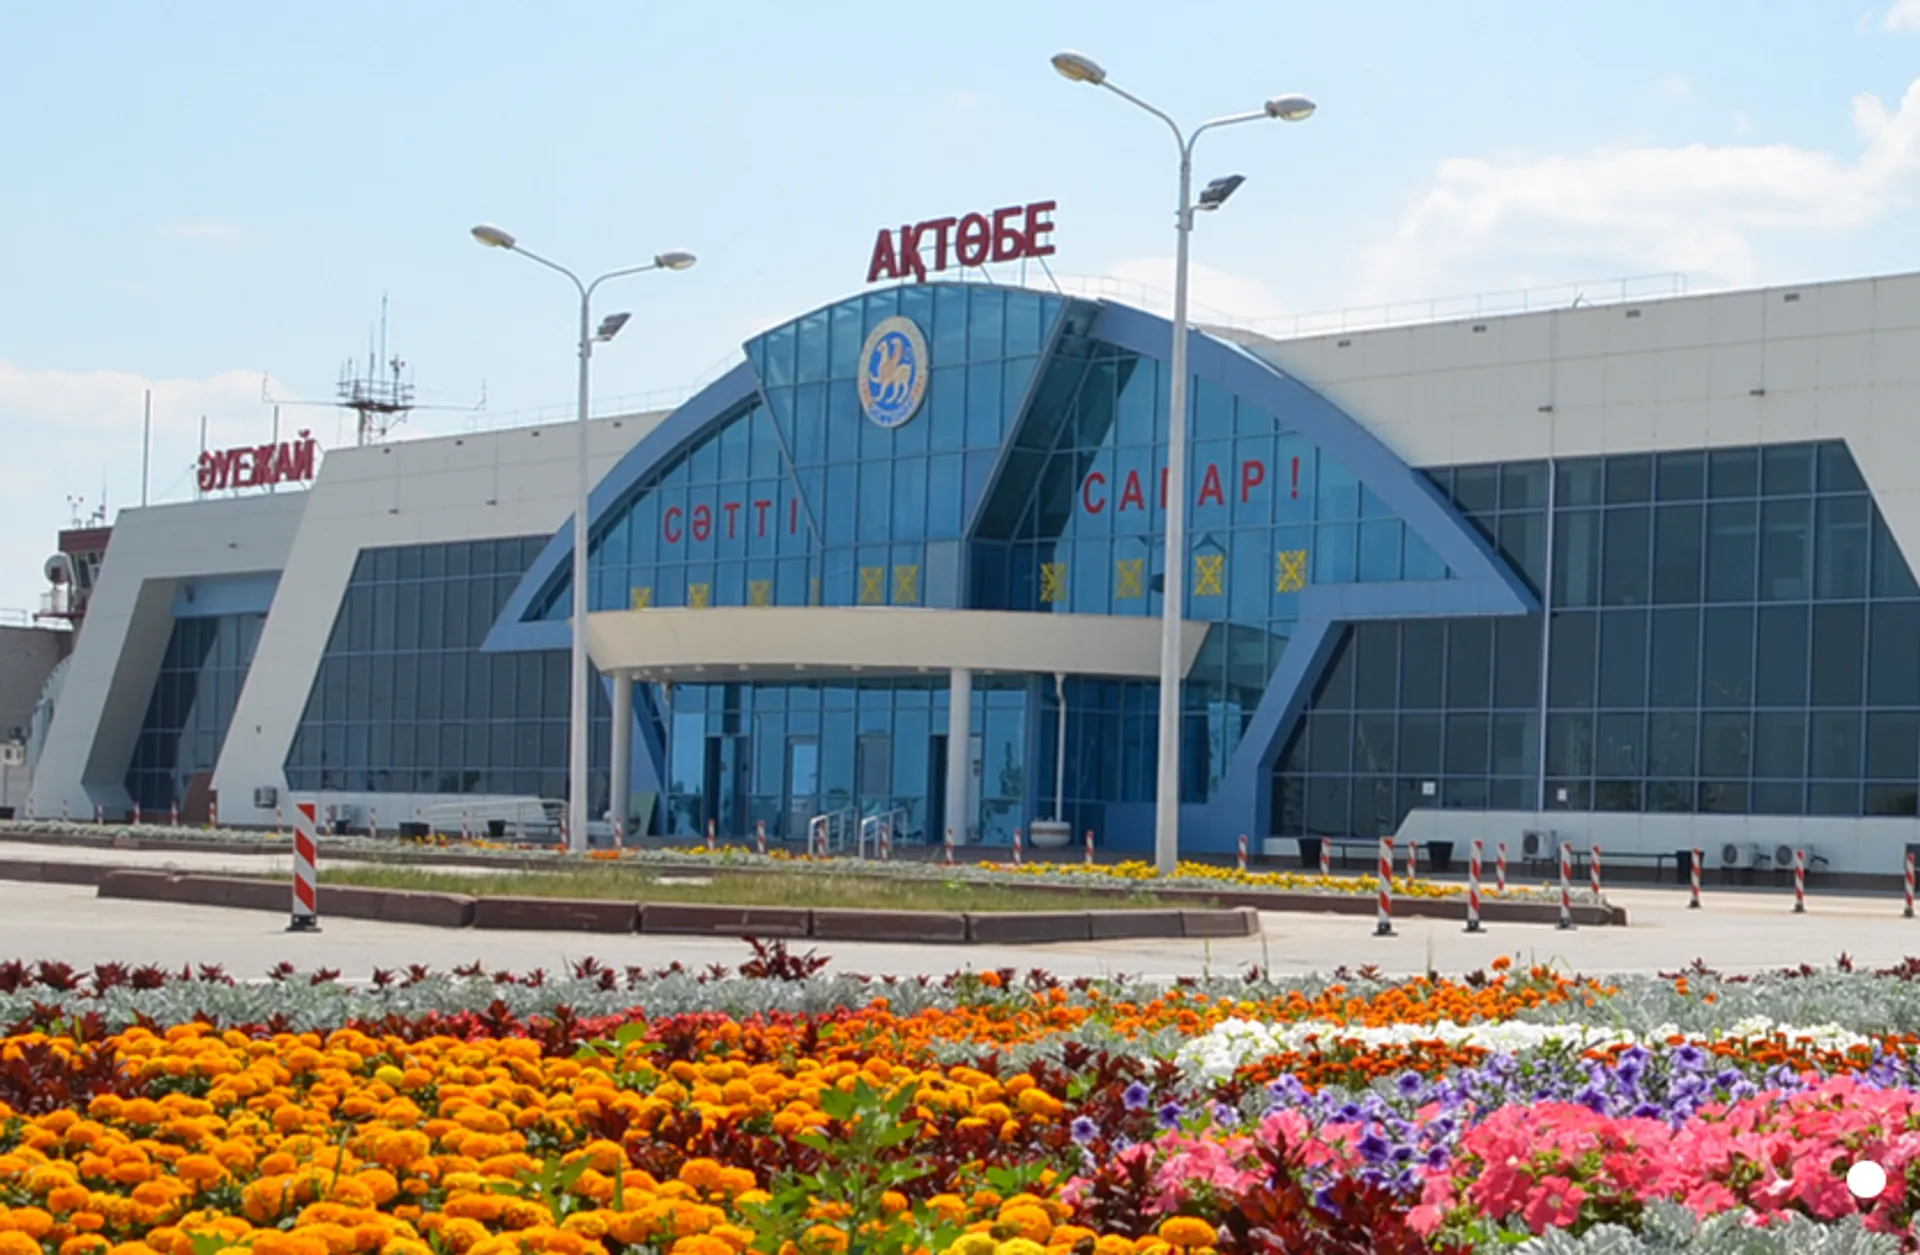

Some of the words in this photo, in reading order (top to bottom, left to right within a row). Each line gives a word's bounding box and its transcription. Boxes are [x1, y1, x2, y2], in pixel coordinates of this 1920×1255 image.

[867, 200, 1056, 283] АҚТӨБЕ
[198, 429, 315, 491] ӘУЕЖАЙ
[664, 498, 798, 543] СӘТТІ
